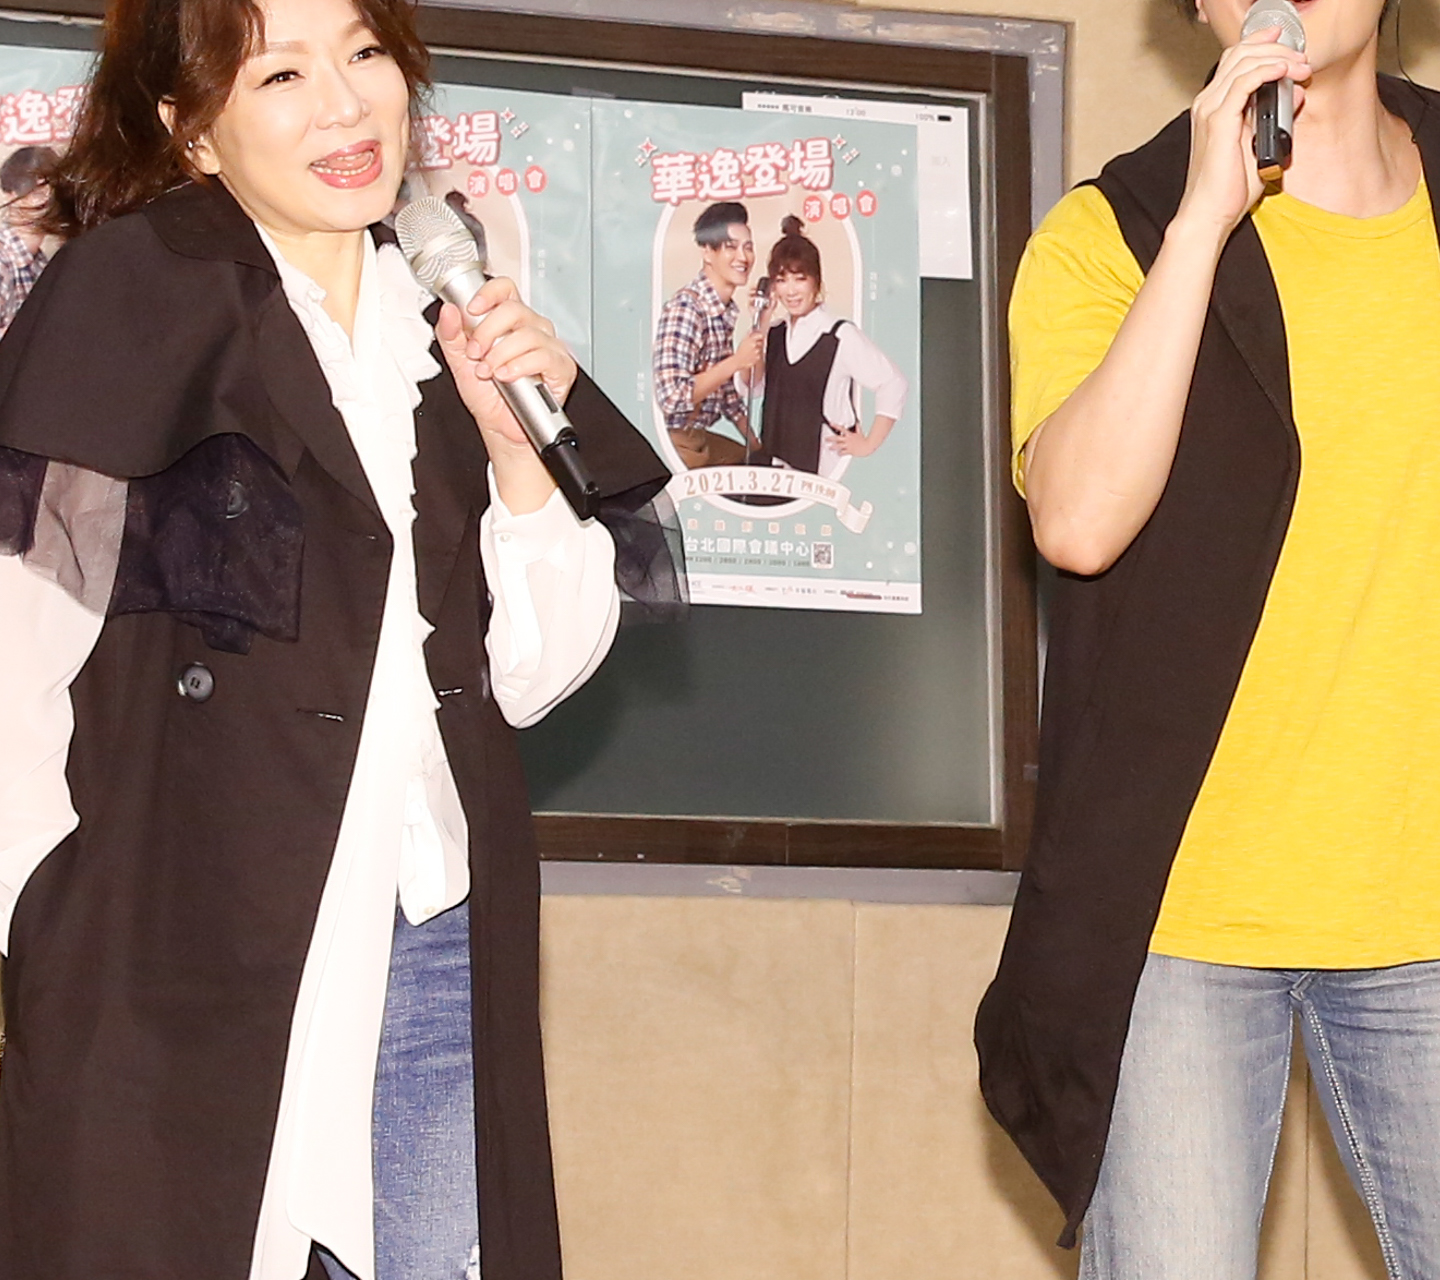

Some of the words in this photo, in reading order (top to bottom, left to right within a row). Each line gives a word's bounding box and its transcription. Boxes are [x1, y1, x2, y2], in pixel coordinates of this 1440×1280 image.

[415, 111, 502, 170] 登場
[468, 166, 547, 198] 演唱會
[651, 137, 834, 205] 華逸登場
[803, 190, 878, 222] 演唱會
[684, 470, 795, 496] 2021.3.27
